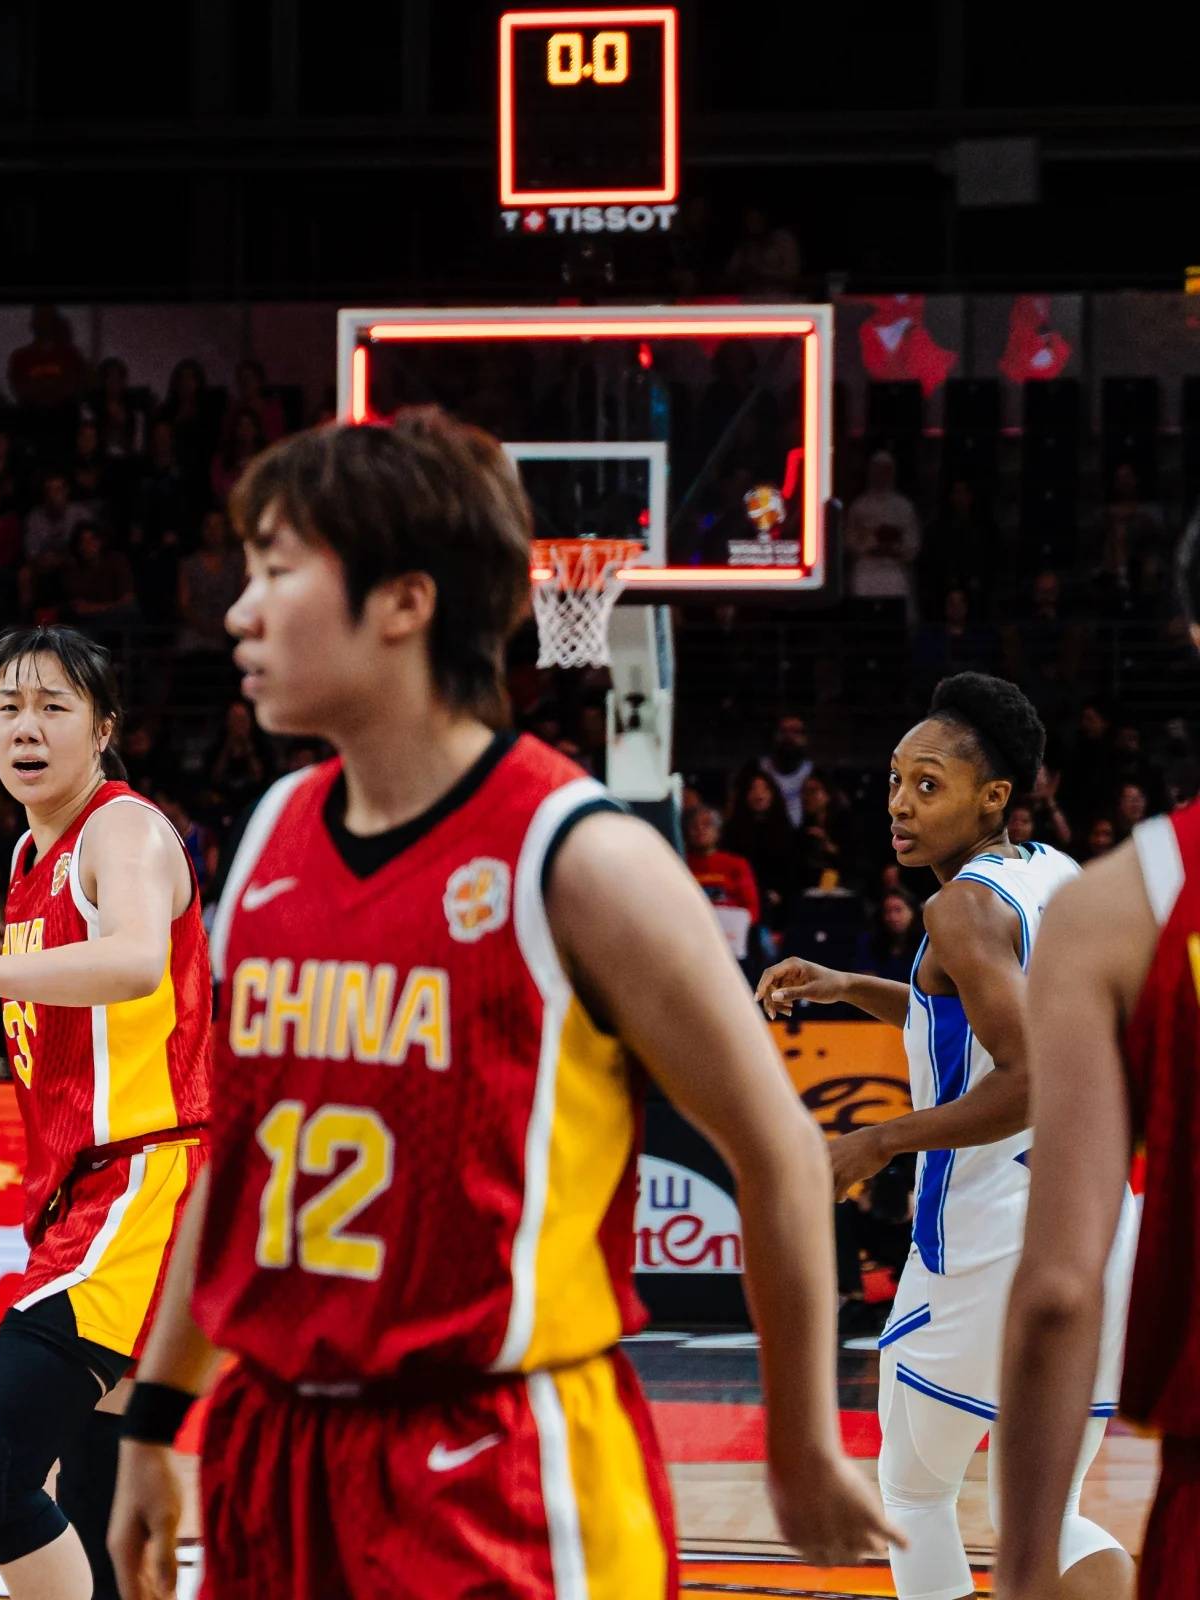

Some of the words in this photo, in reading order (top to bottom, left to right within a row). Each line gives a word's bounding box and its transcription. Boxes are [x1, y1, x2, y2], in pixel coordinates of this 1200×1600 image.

[547, 31, 629, 85] 0.0
[549, 205, 676, 232] TISSOT
[229, 957, 451, 1071] CHINA
[256, 1100, 395, 1281] 12
